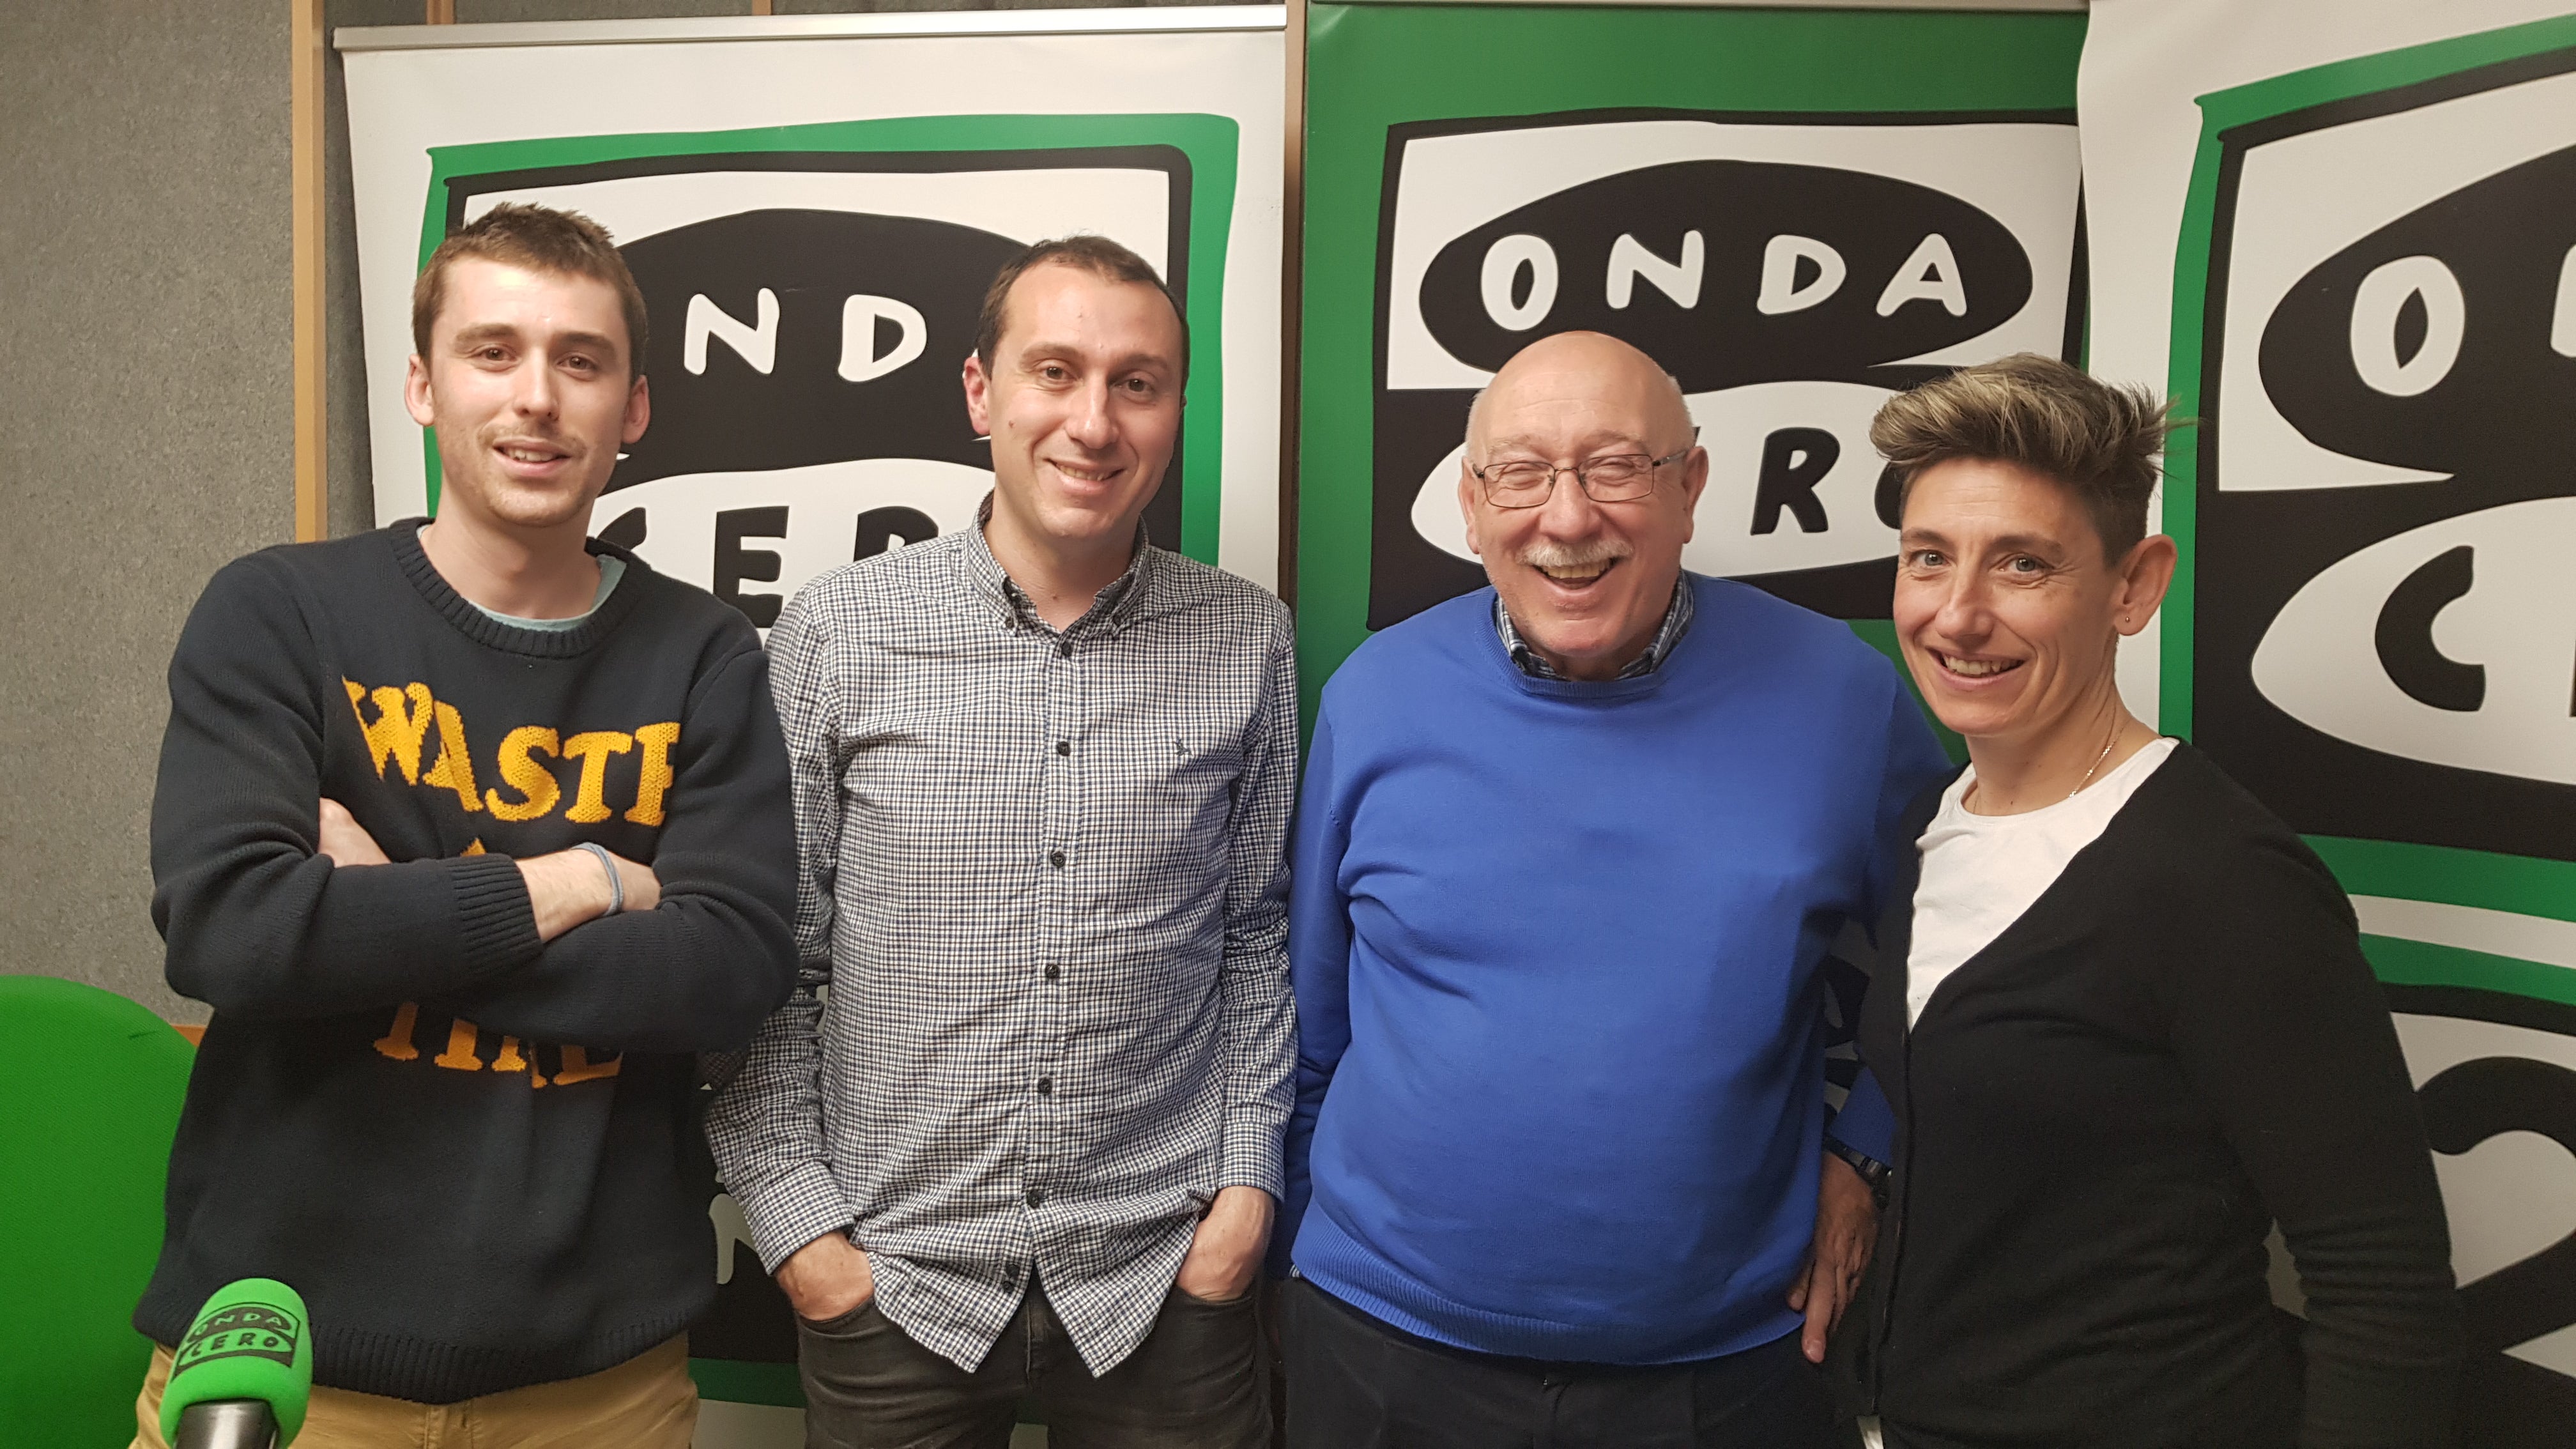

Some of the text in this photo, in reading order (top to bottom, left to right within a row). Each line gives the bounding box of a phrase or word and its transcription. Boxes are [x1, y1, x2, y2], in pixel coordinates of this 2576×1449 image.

[1479, 229, 1968, 332] ONDA
[684, 287, 928, 382] ND
[191, 1332, 279, 1357] CERO
[194, 1312, 282, 1336] ONDA
